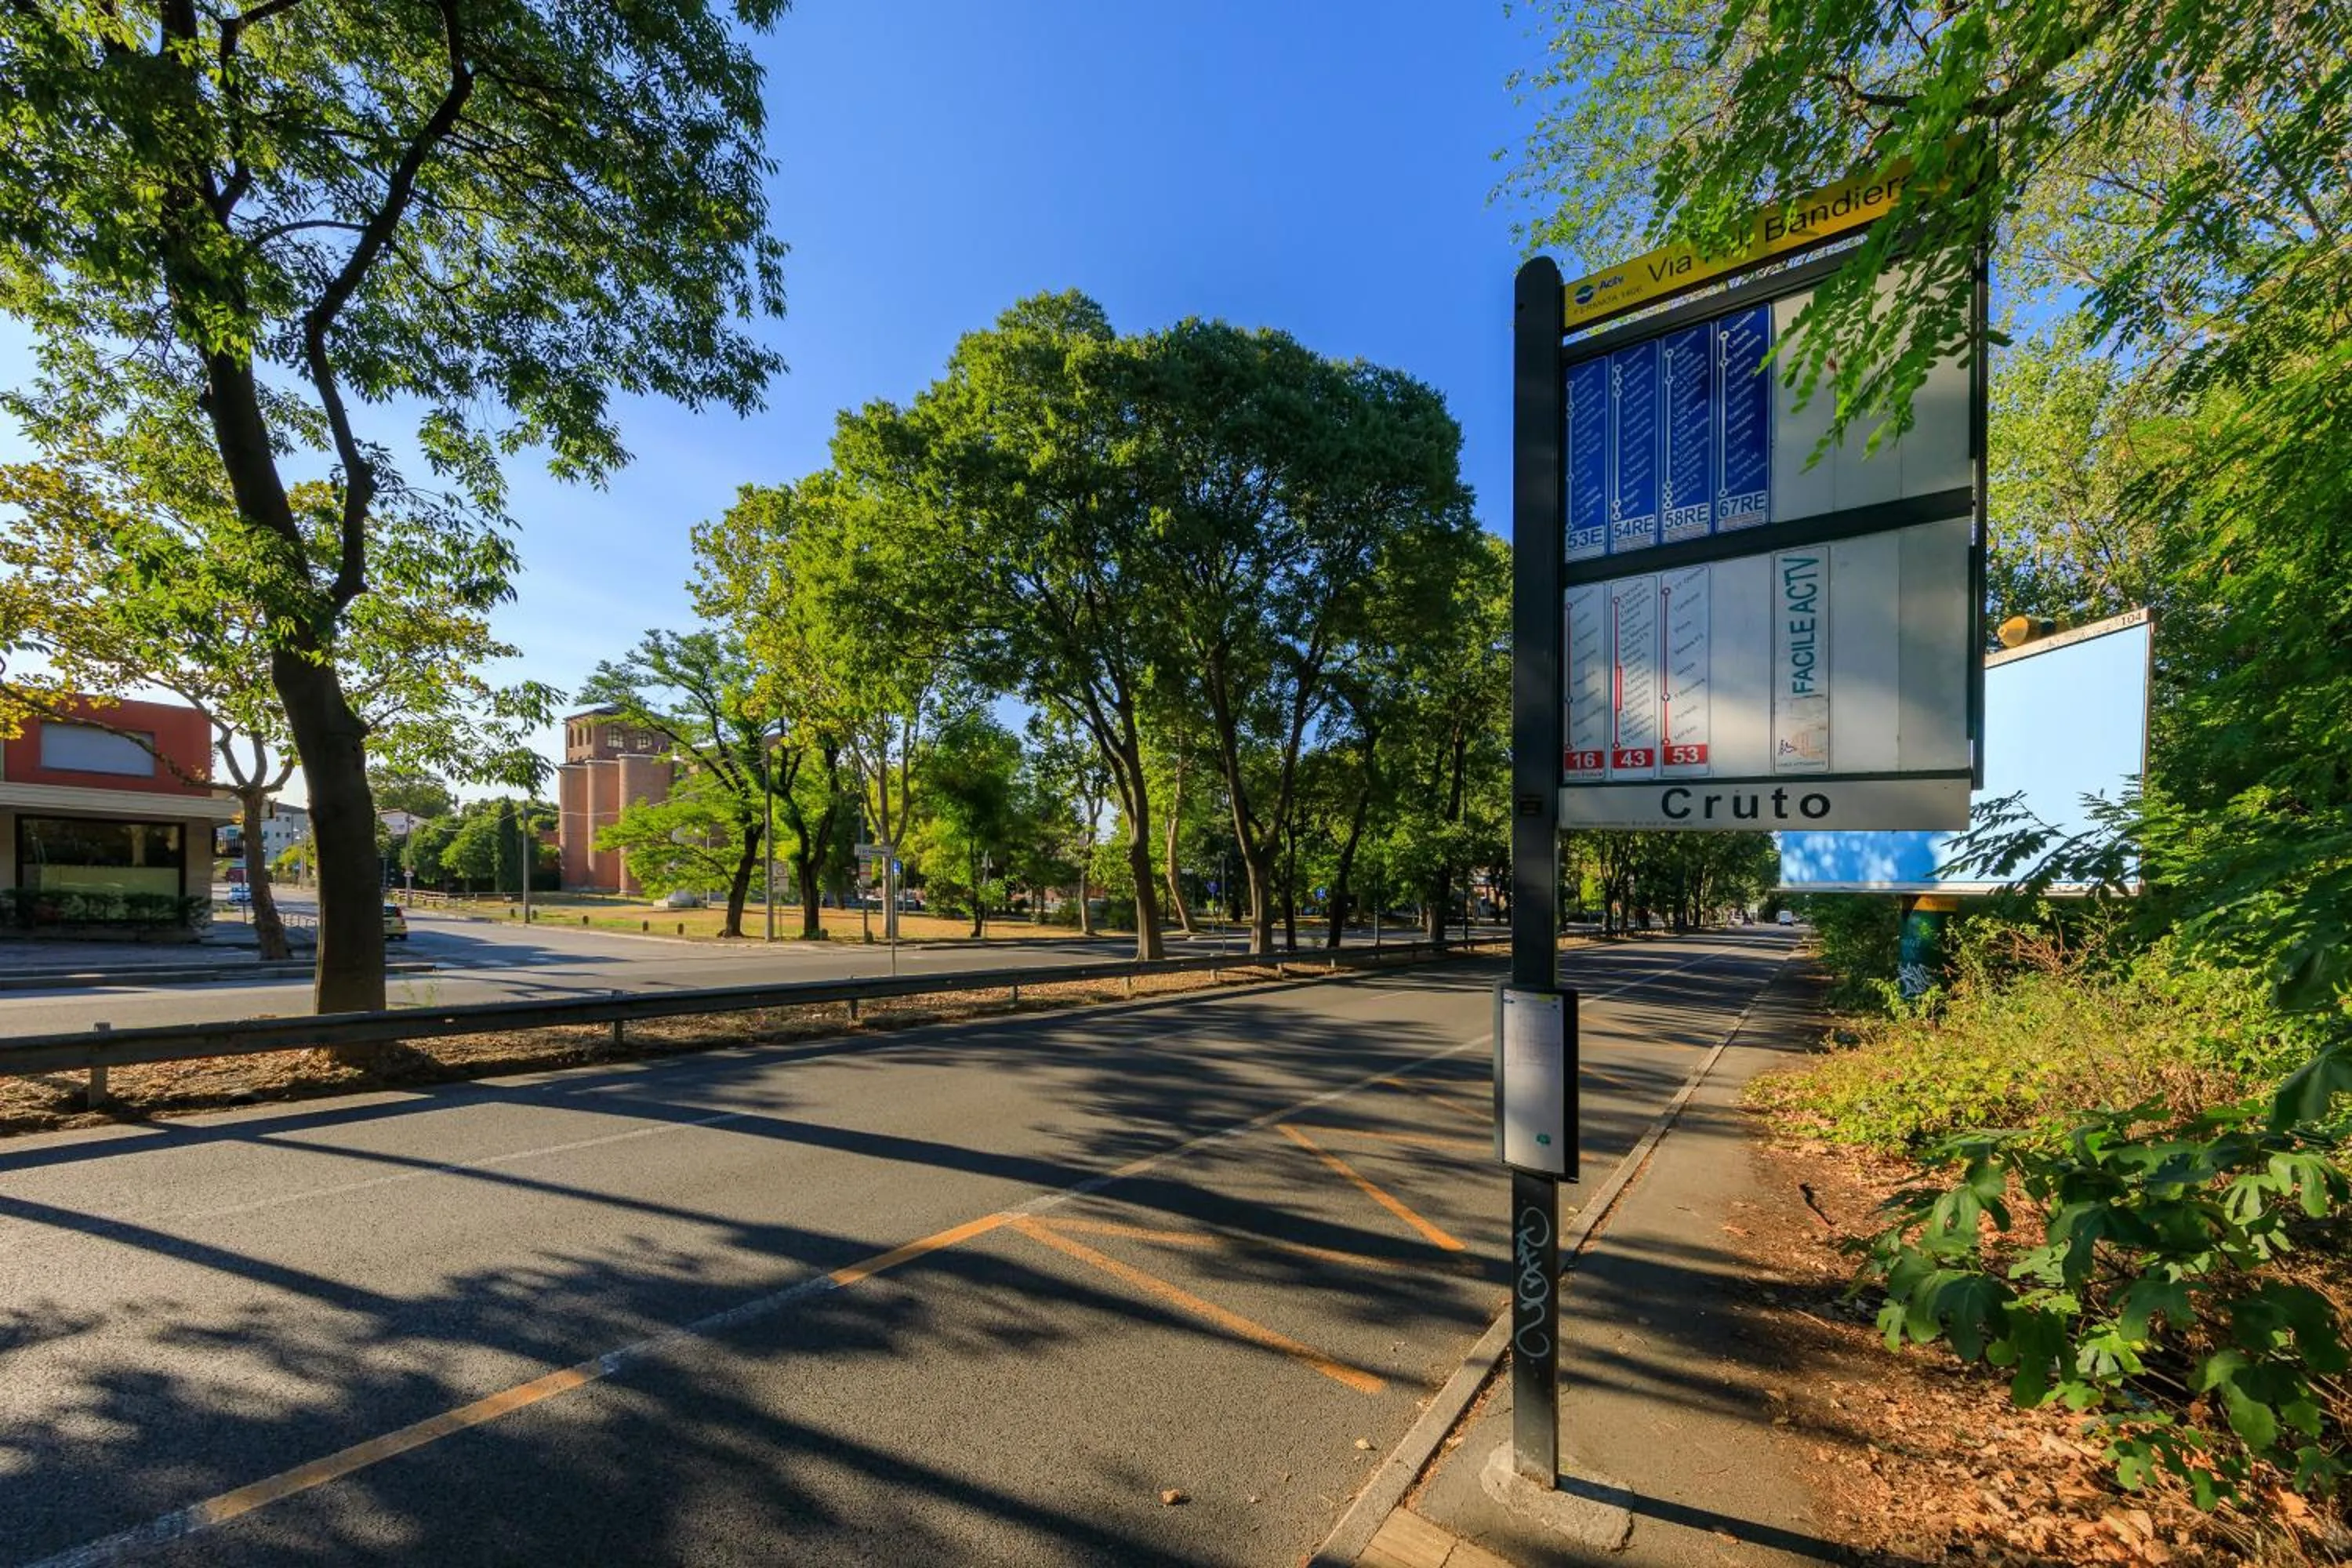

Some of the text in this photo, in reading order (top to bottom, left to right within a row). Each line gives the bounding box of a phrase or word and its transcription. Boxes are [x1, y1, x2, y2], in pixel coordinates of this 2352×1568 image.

[1647, 175, 1911, 283] Via Bandier
[1719, 493, 1766, 517] 67RE
[1614, 517, 1653, 538] 54RE
[1664, 506, 1708, 528] 58RE
[1568, 528, 1603, 548] 53E
[1782, 557, 1820, 695] FACILE ACTV
[1573, 753, 1595, 769] 16
[1621, 750, 1646, 767] 43
[1672, 746, 1699, 764] 53
[1661, 786, 1831, 819] Cruto
